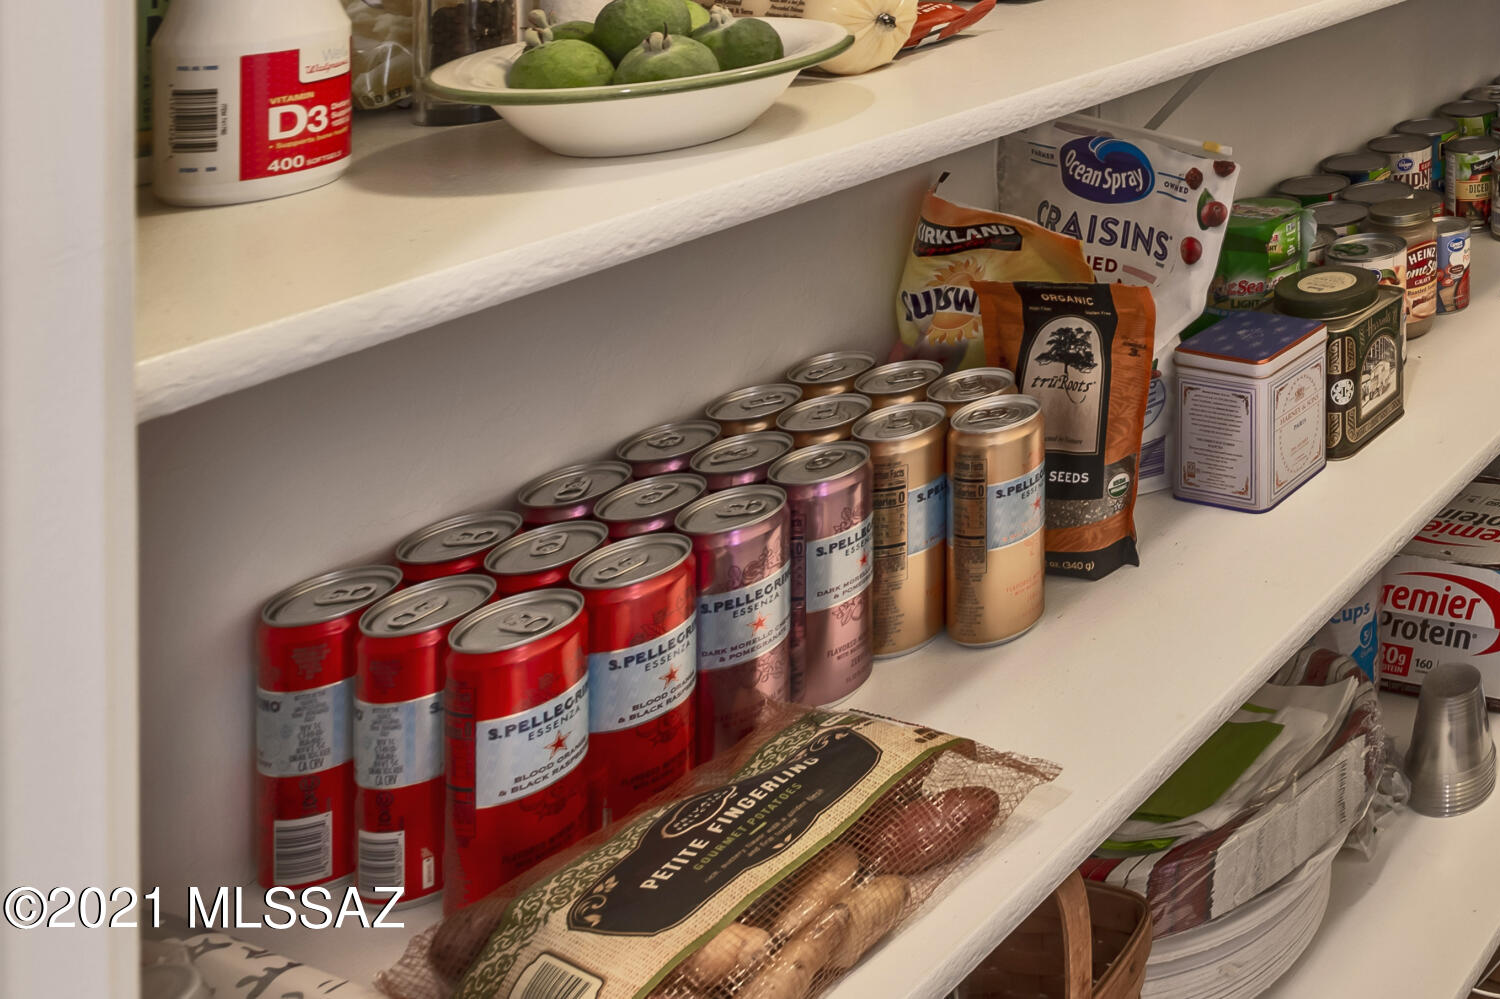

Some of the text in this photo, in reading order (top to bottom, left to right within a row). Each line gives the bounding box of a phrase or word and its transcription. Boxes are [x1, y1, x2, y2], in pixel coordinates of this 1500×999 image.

[268, 90, 315, 104] VITAMIN
[267, 103, 329, 141] D3
[266, 150, 342, 172] 400 SOFTGELS
[1065, 149, 1144, 194] Ocean Spray
[1164, 180, 1190, 195] OWNED
[1468, 182, 1489, 195] DICED
[917, 222, 1019, 245] KIRKLAND
[1036, 200, 1169, 262] CRAISINS
[1408, 247, 1436, 265] HEINZ
[1237, 278, 1265, 295] Sea
[1040, 292, 1095, 306] ORGANIC
[1049, 471, 1090, 484] SEEDS
[1062, 559, 1096, 572] (340 g)
[732, 591, 780, 619] ESSENZA
[701, 630, 773, 658] DARK MORELLO
[644, 640, 691, 673] ESSENZA
[1415, 657, 1434, 670] 160
[628, 703, 665, 722] BLACK
[631, 693, 670, 712] BLOOD
[528, 704, 582, 742] ESSENZA
[513, 759, 555, 786] BLOOD
[510, 773, 550, 796] BLACK
[639, 756, 820, 890] PETITE FINGERLING
[693, 825, 748, 871] GOURMET
[747, 782, 803, 827] POTATOES
